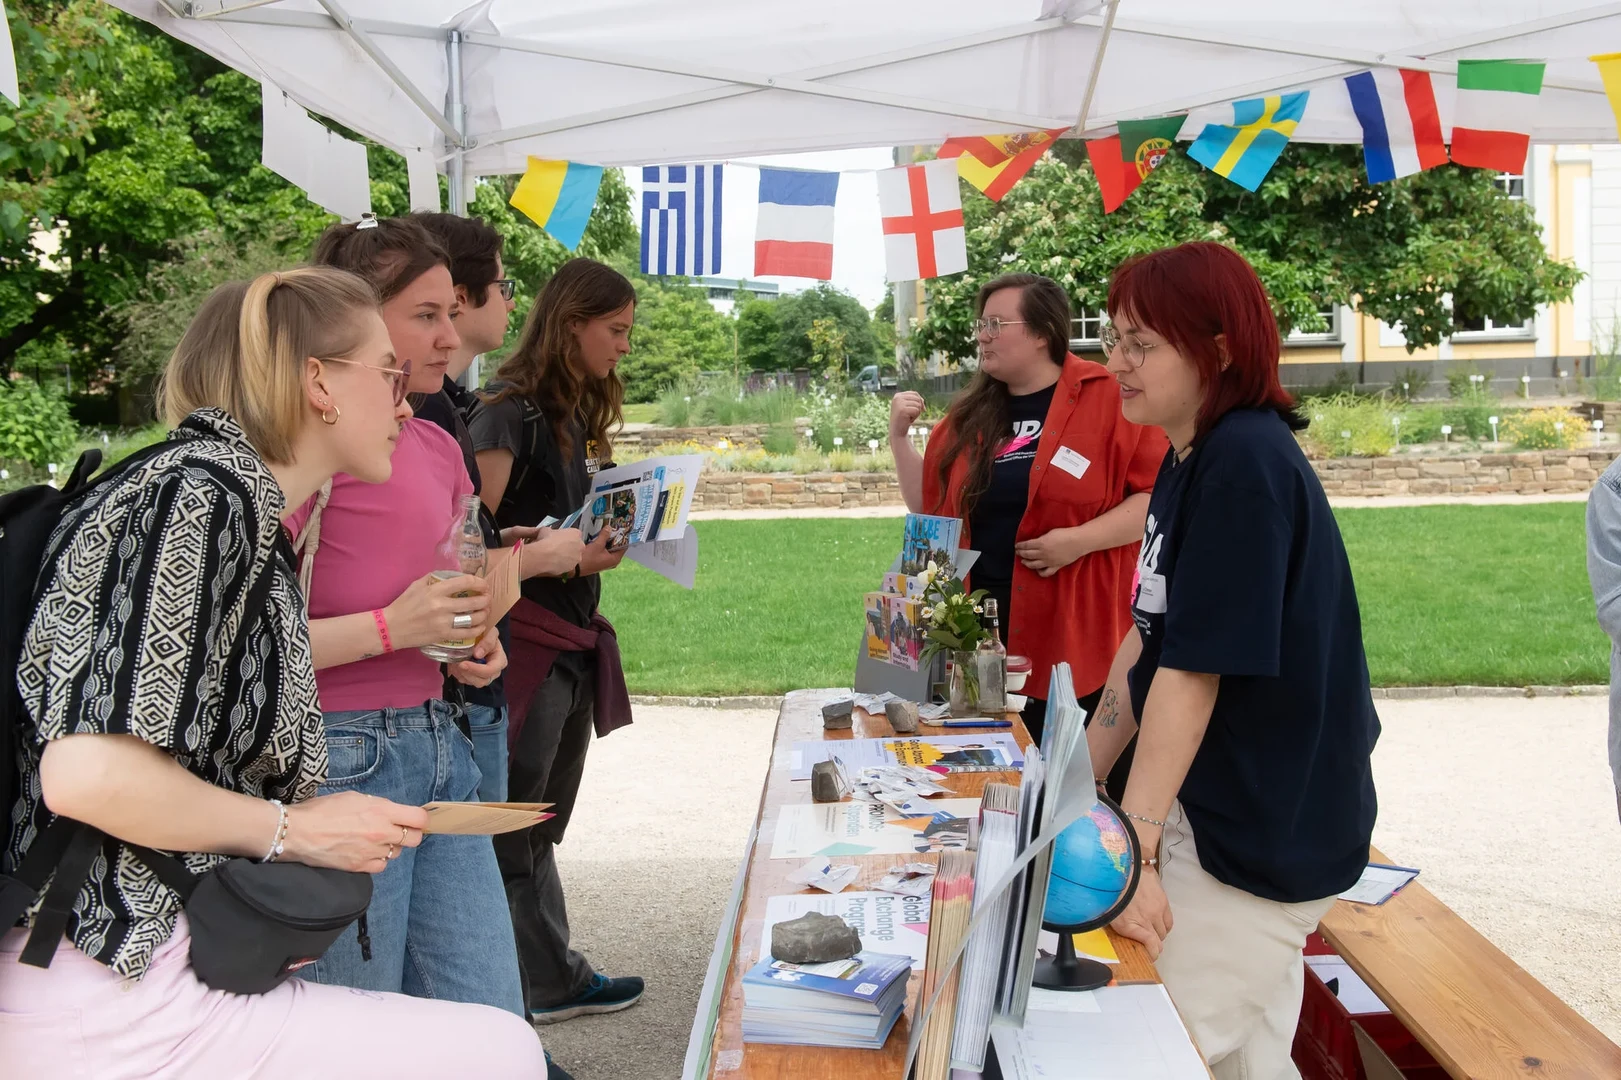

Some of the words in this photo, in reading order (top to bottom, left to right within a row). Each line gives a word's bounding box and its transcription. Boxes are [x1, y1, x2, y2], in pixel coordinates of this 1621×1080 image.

[585, 457, 600, 467] ELECT
[868, 896, 896, 942] Exchange
[902, 895, 924, 924] Global
